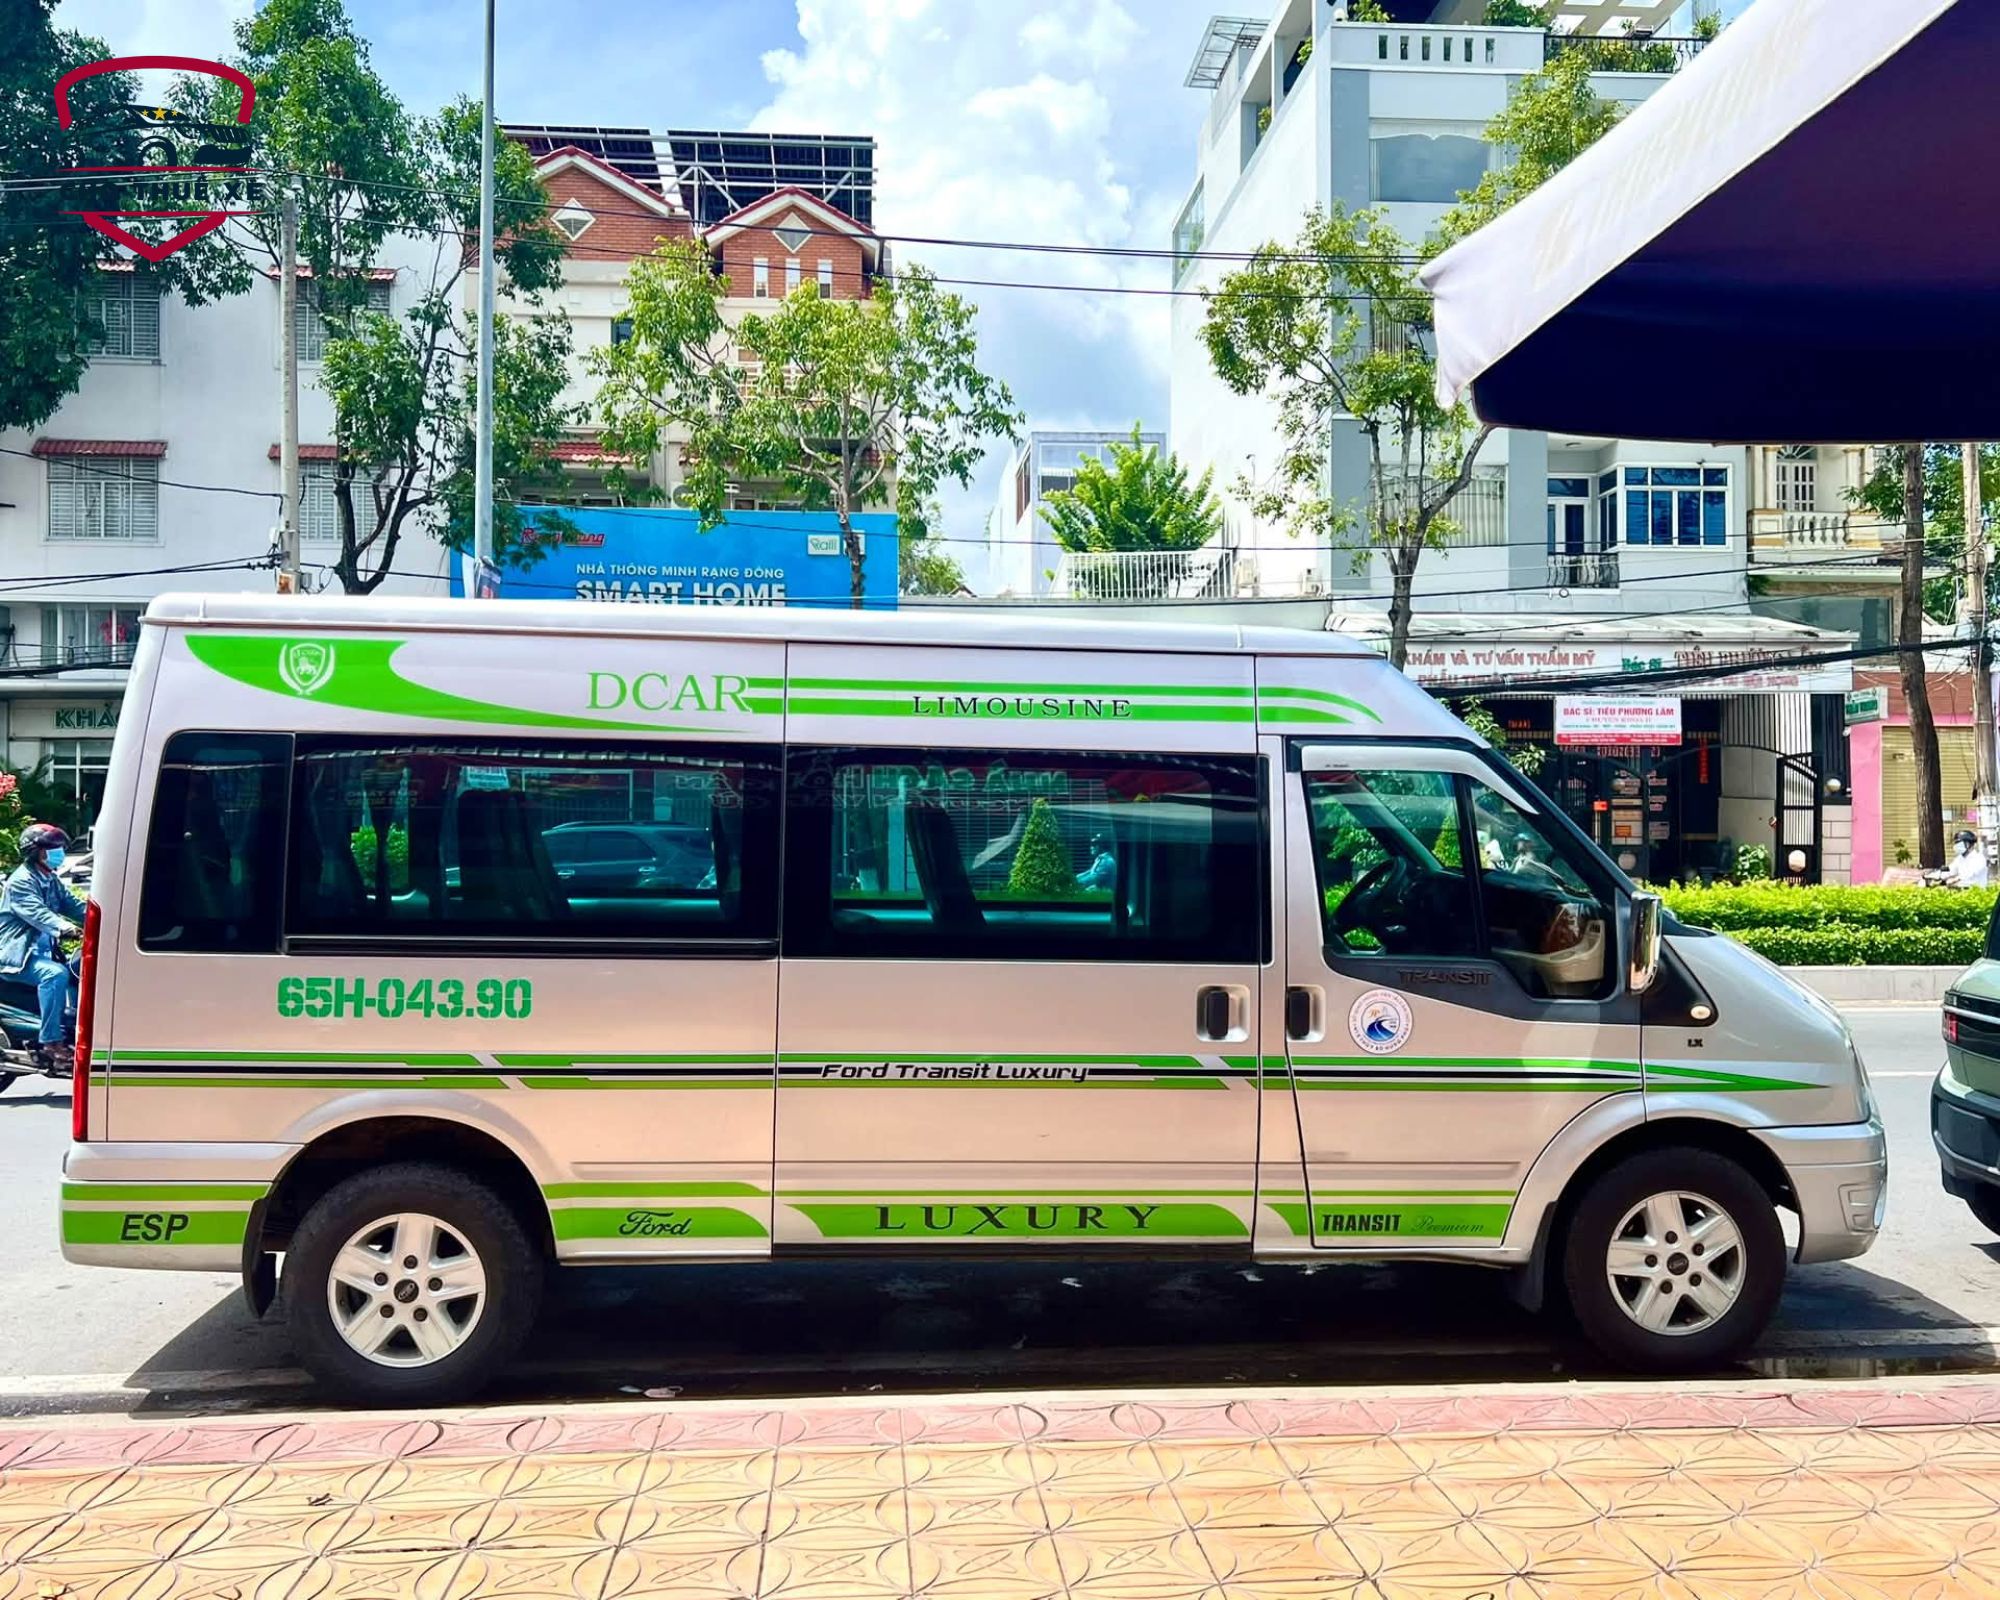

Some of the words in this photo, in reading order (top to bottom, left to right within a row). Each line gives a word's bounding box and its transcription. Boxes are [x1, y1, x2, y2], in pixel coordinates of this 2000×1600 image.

[576, 562, 605, 575] NHÀ
[611, 563, 657, 576] THÔNG
[662, 566, 697, 576] MINH
[701, 567, 739, 578] RẠNG
[744, 566, 784, 579] ĐÔNG
[576, 579, 682, 605] SMART
[693, 582, 786, 607] HOME
[1451, 650, 1469, 666] VÀ
[1473, 651, 1494, 666] TƯ
[1497, 648, 1525, 666] VẤN
[1528, 646, 1571, 666] THẨM
[1573, 650, 1596, 666] MỸ
[586, 672, 750, 712] DCAR
[913, 696, 1131, 717] LIMOUSINE
[1397, 969, 1492, 985] TRANSIT
[277, 977, 533, 1019] 65H-043.90
[1687, 1038, 1704, 1048] LX
[821, 1063, 890, 1079] Ford
[895, 1063, 991, 1080] Transit
[997, 1065, 1088, 1083] Luxury
[120, 1213, 189, 1242] ESP
[619, 1210, 692, 1235] Ford
[874, 1205, 1162, 1235] LUXURY
[1322, 1214, 1401, 1232] TRANSIT
[1411, 1215, 1484, 1233] Premium
